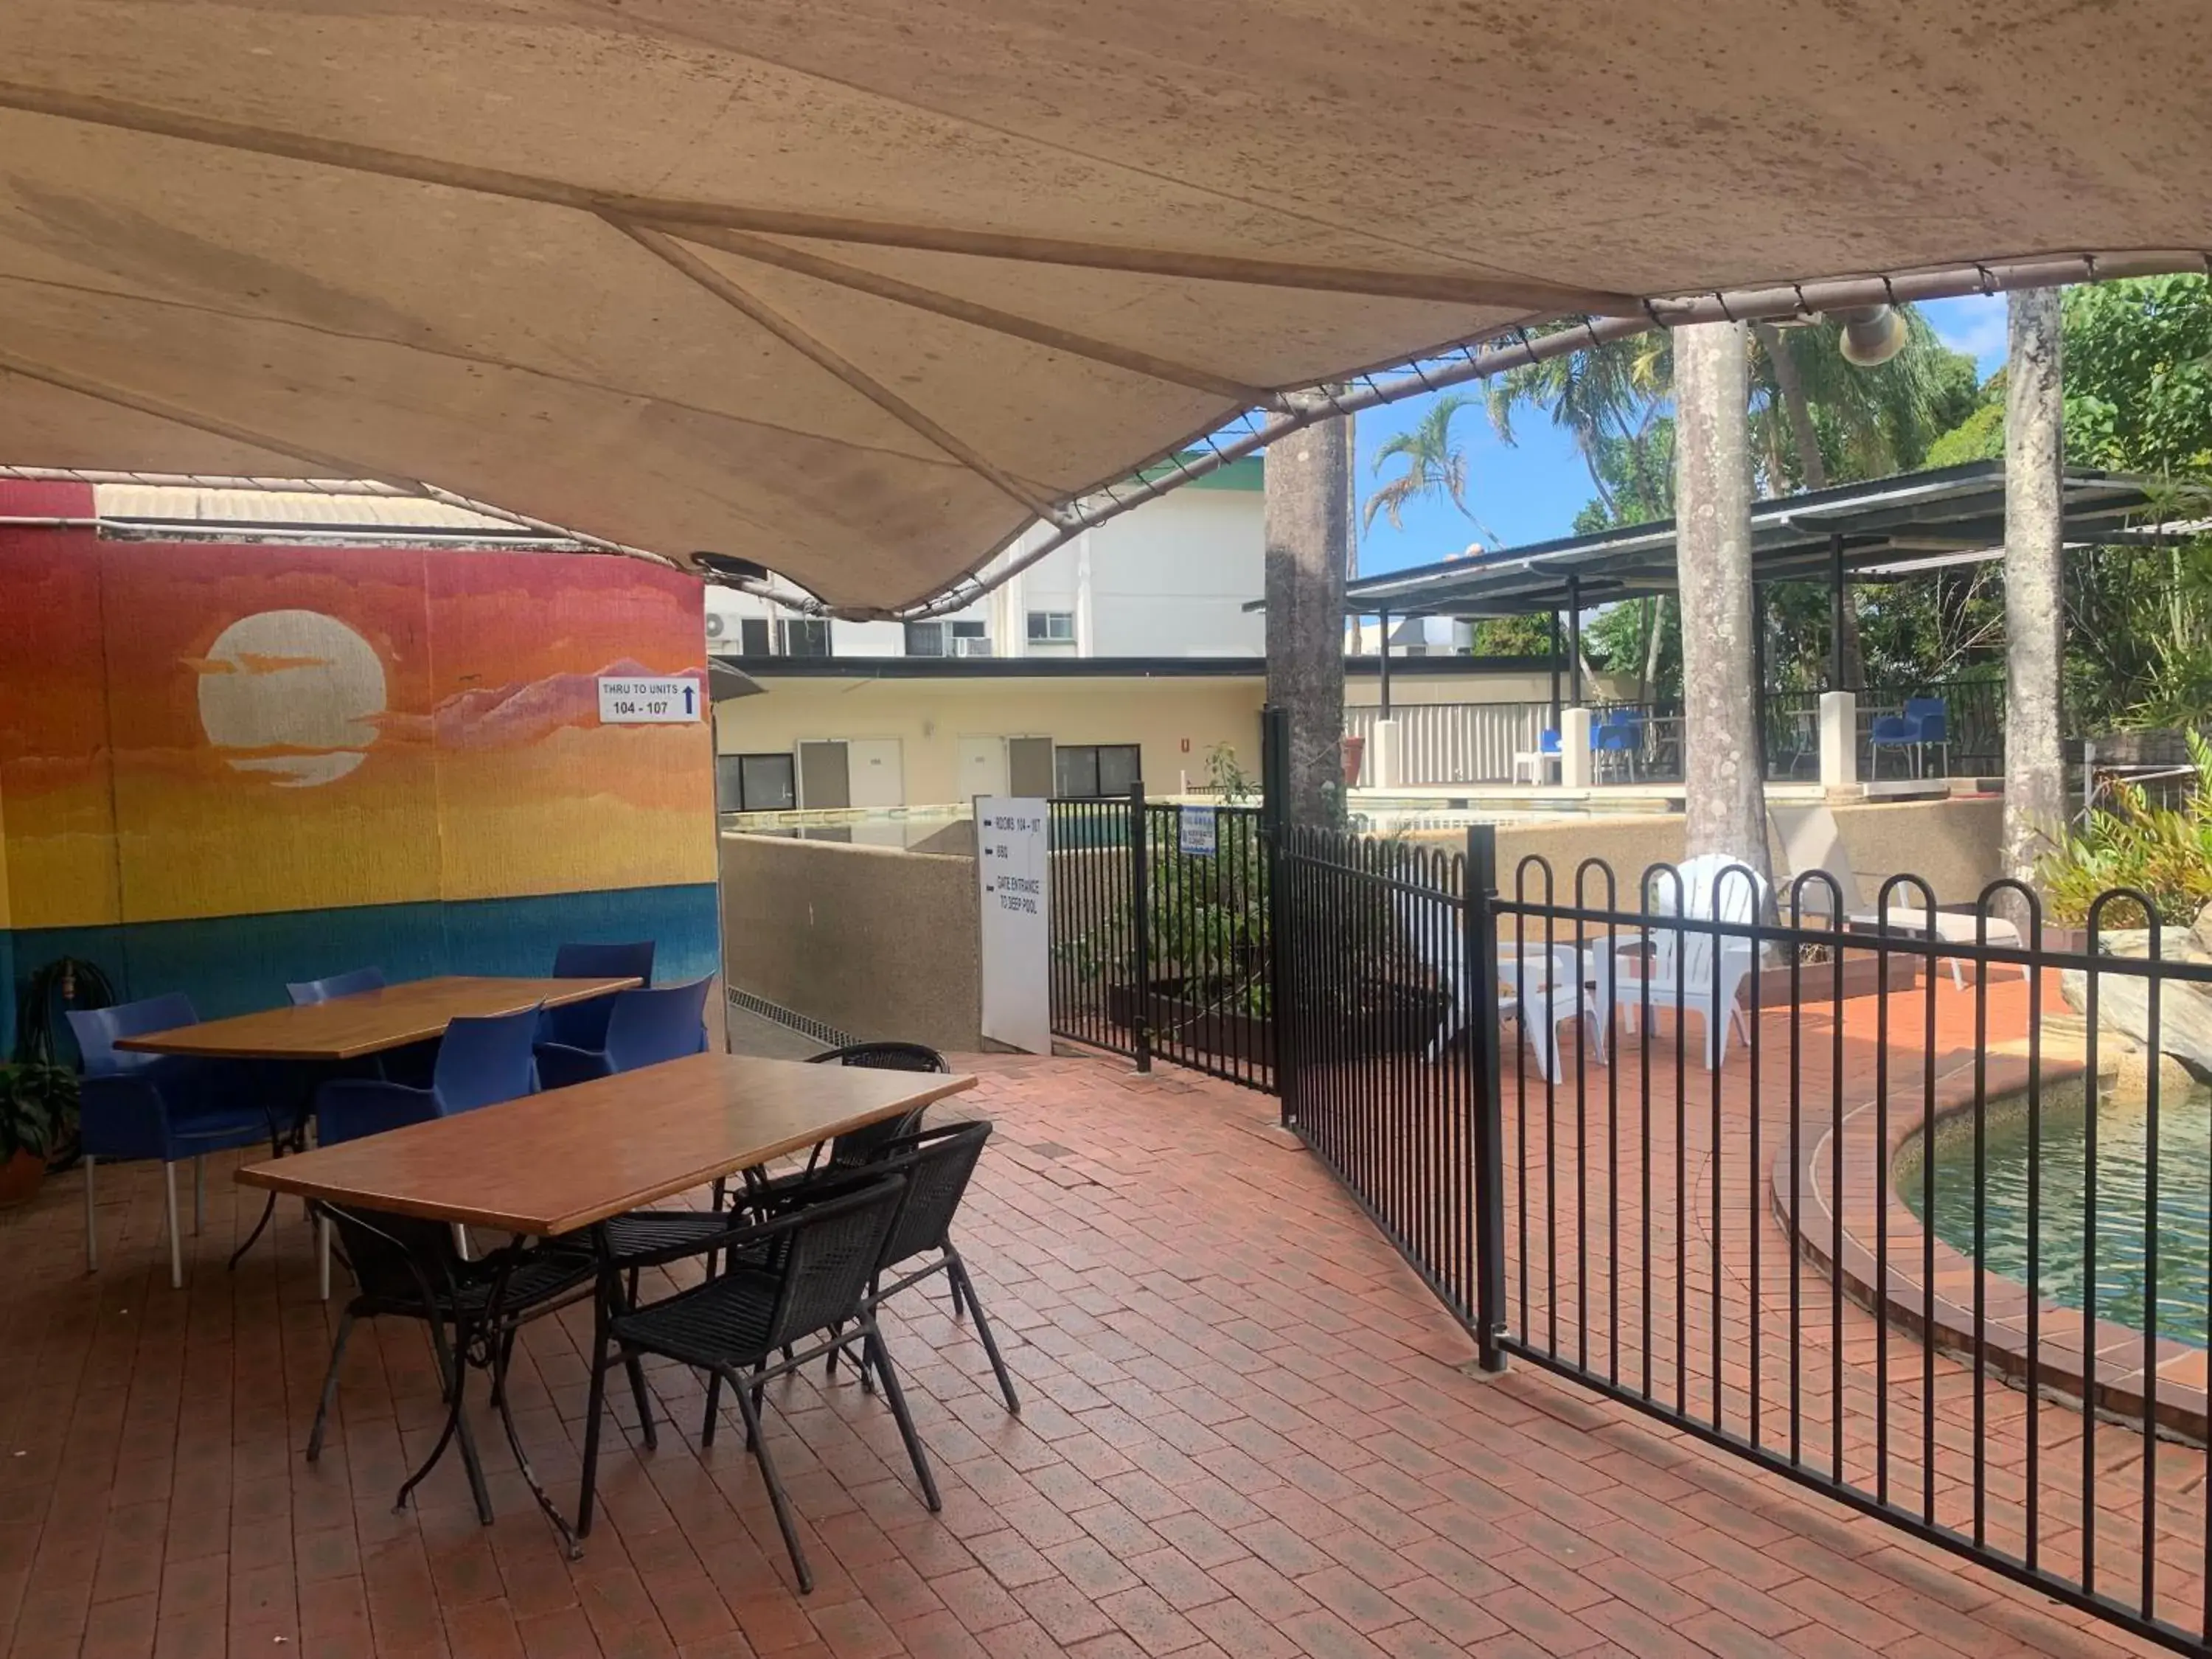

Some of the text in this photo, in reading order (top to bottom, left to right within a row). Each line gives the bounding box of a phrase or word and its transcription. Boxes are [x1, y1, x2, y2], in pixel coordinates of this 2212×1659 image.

[602, 684, 678, 694] THRU TO UNITS
[613, 701, 635, 714] 104
[646, 701, 668, 714] 107
[995, 815, 1015, 831] ROOMS
[1017, 818, 1026, 831] 104
[998, 875, 1039, 894] GATE ENTRANCE
[1000, 894, 1037, 914] TO DEEP POOL
